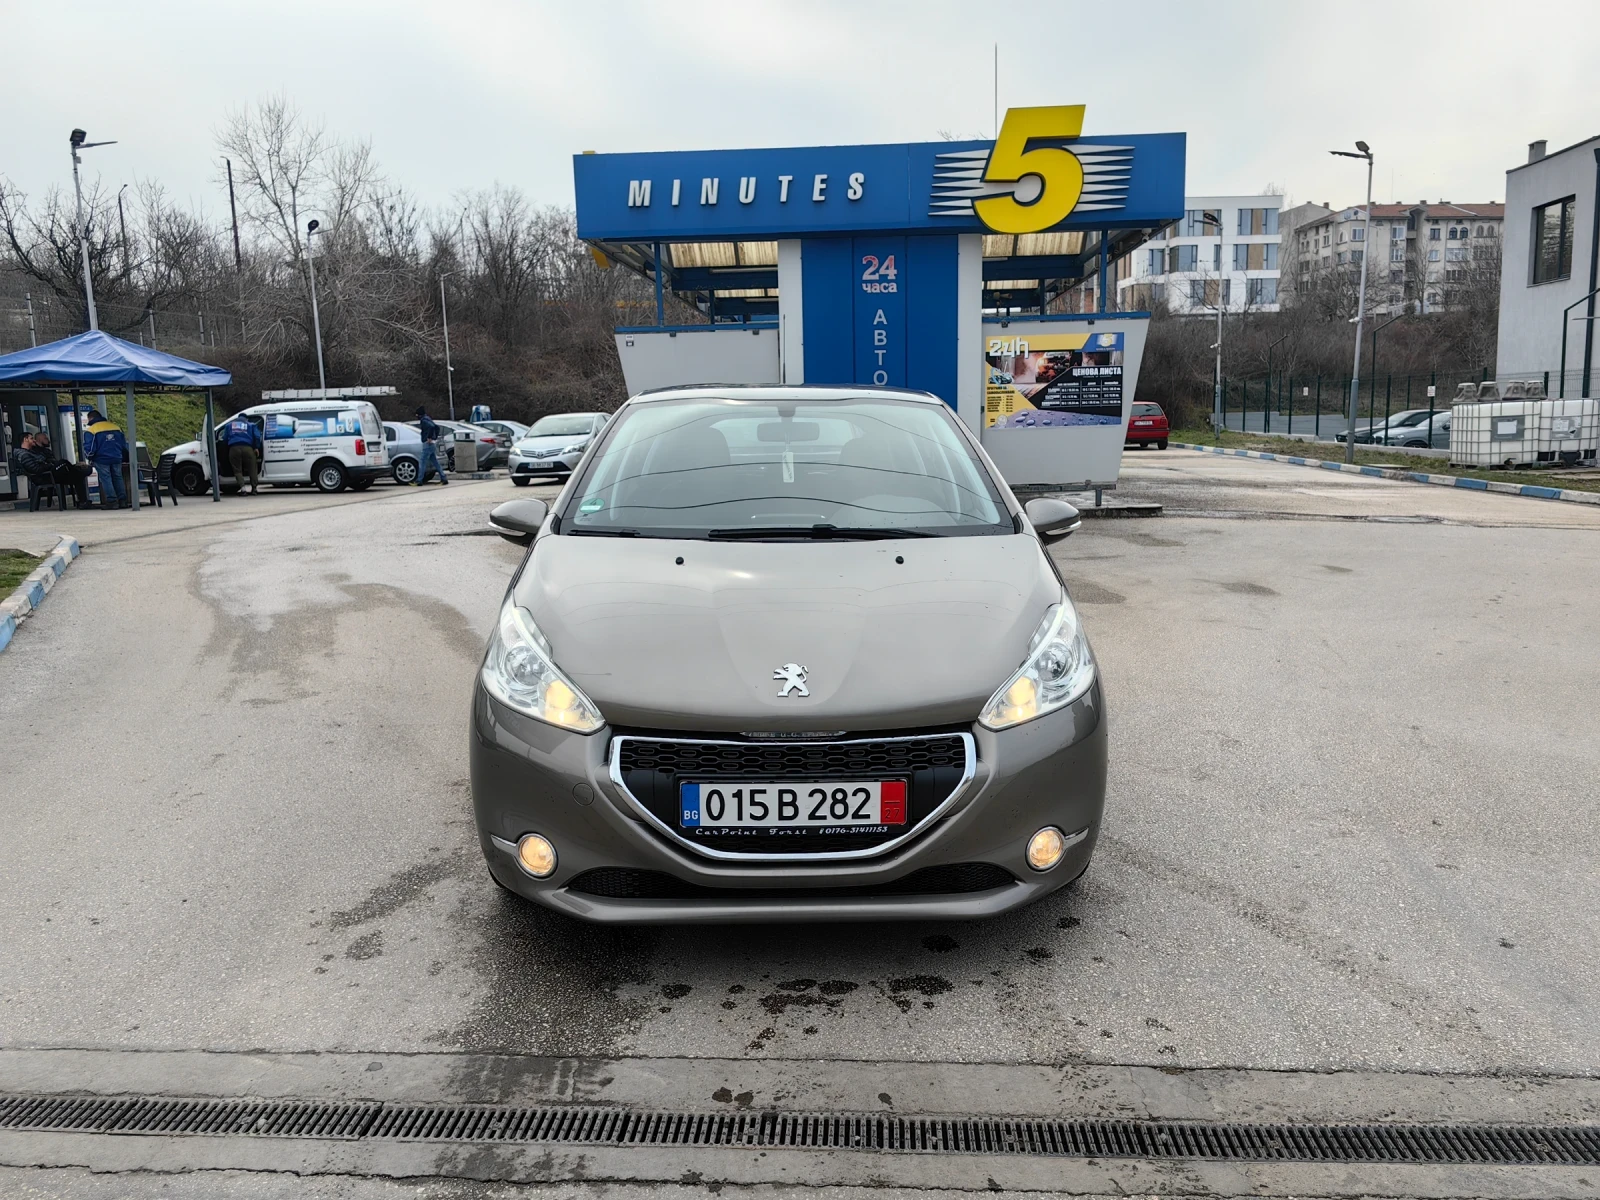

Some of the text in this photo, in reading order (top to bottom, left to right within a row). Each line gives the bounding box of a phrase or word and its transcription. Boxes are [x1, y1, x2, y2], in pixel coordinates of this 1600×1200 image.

[973, 104, 1086, 235] 5
[627, 172, 866, 208] MINUTES
[862, 255, 897, 280] 24
[862, 282, 897, 293] часа
[873, 309, 888, 386] АВТО
[989, 337, 1029, 359] 24h
[1072, 366, 1122, 377] ЦЕНОВА ЛИСТА
[684, 810, 698, 821] BG
